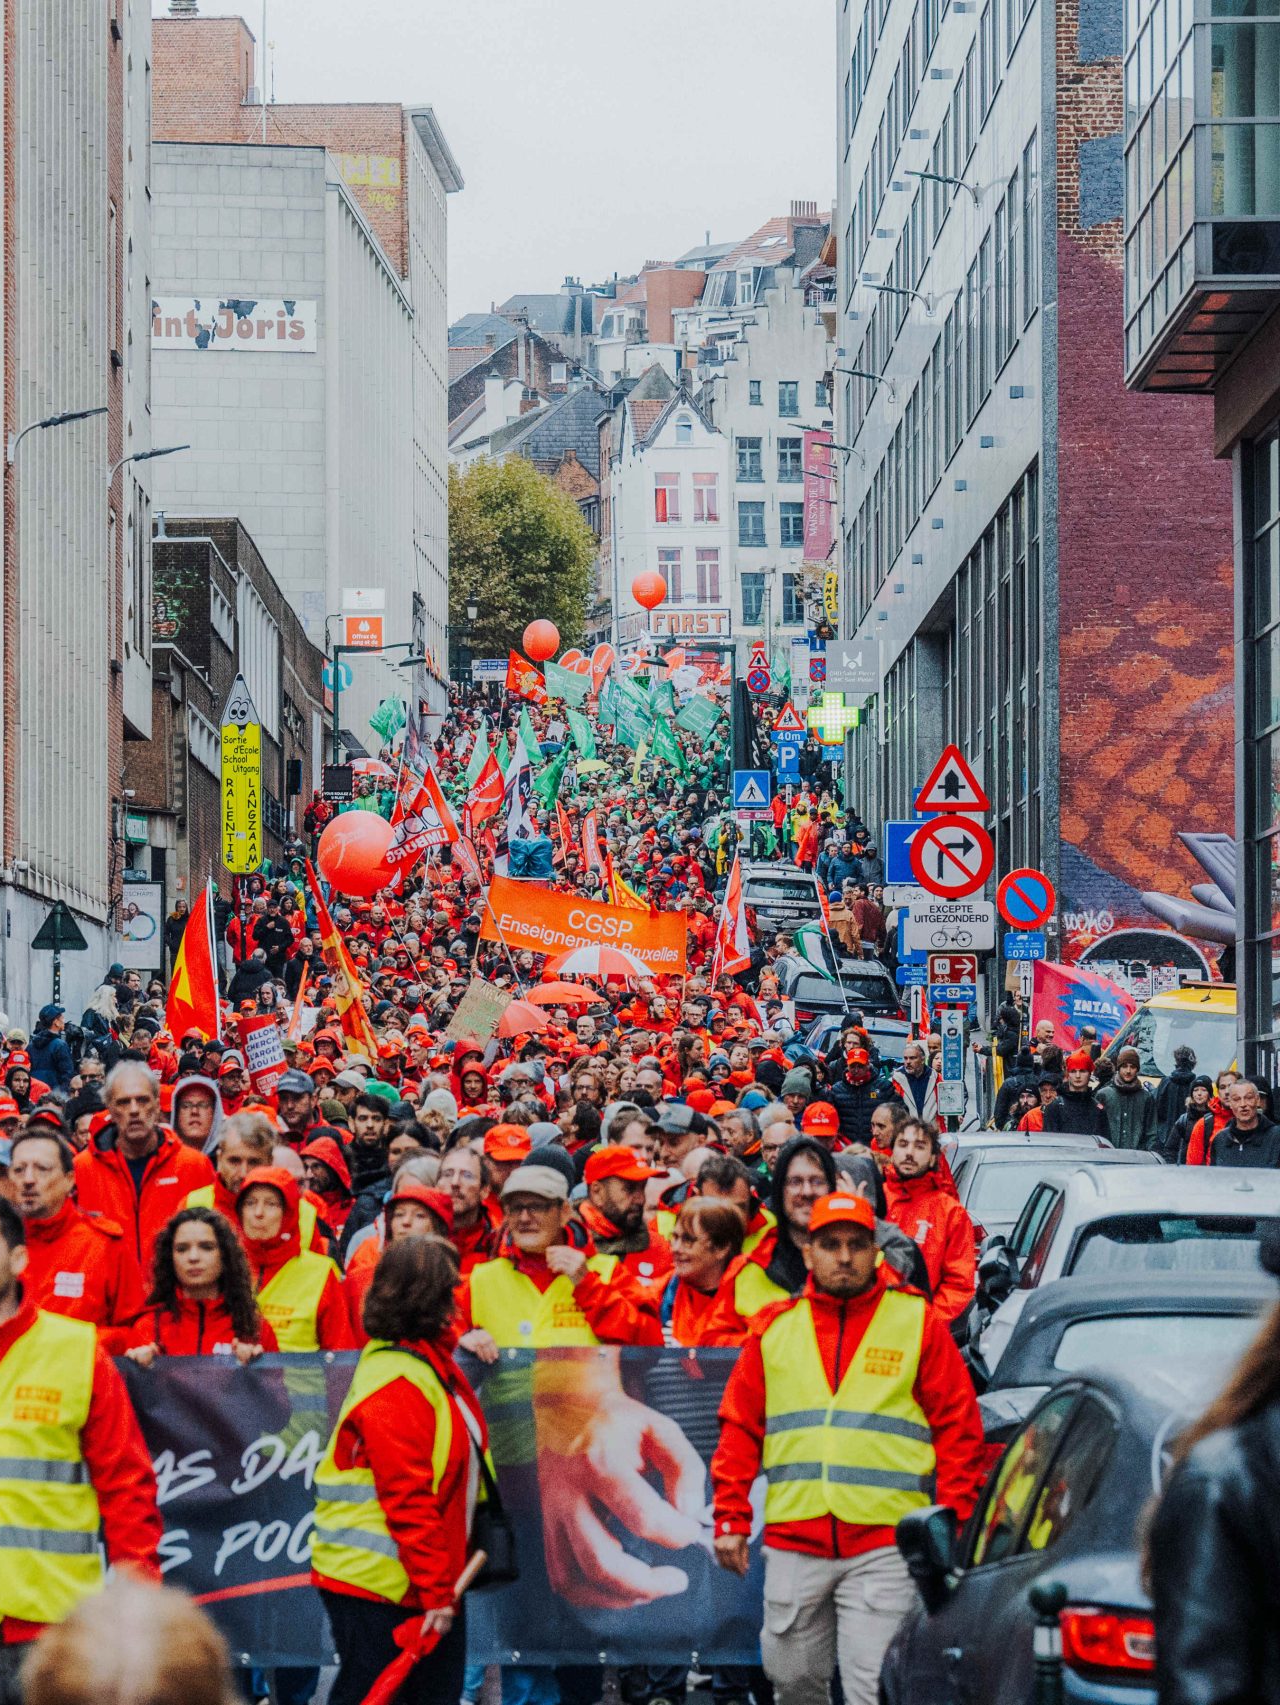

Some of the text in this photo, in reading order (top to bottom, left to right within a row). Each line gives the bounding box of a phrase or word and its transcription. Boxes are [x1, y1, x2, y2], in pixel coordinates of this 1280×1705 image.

[153, 306, 306, 341] int-Joris
[808, 489, 818, 498] DE
[808, 500, 818, 537] MAISON
[652, 613, 727, 634] FORST
[223, 735, 247, 744] Sortie
[777, 732, 801, 741] 40m
[233, 745, 259, 754] d'Ecole
[223, 755, 248, 763] School
[781, 747, 796, 768] P
[232, 765, 260, 775] Uitgang
[247, 778, 258, 864] LANGZAAM
[929, 905, 974, 913] EXCEPTE
[568, 909, 633, 939] CGSP
[914, 914, 989, 923] UITGEZONDERD
[619, 942, 679, 962] Bruxelles
[948, 989, 958, 997] SZ
[1073, 999, 1120, 1017] INTAL
[230, 1429, 326, 1495] DA
